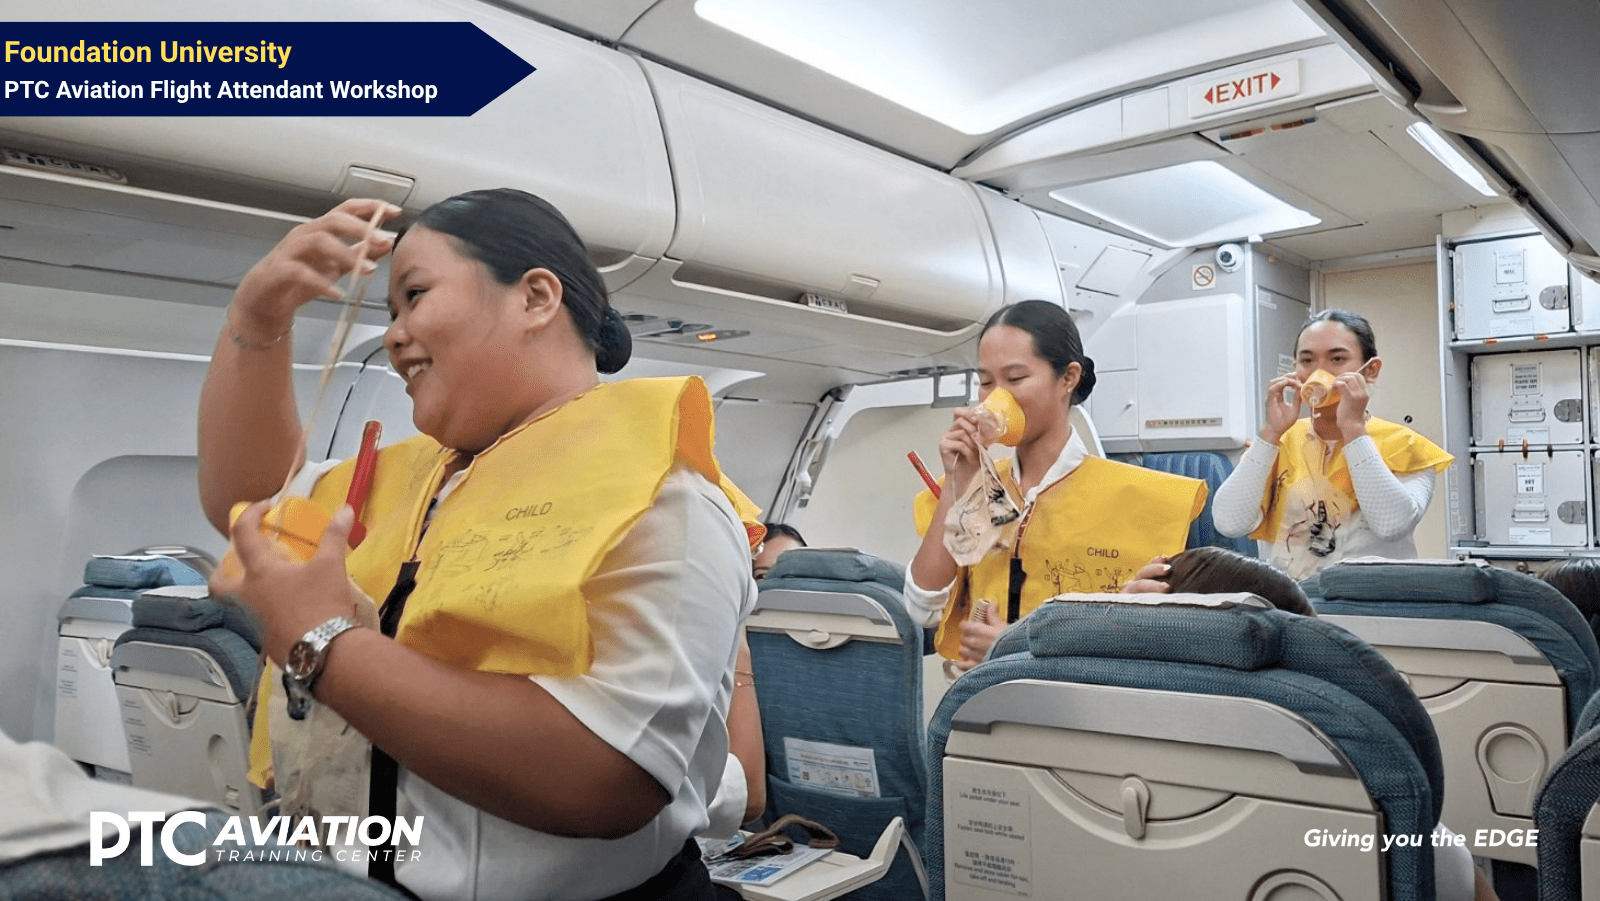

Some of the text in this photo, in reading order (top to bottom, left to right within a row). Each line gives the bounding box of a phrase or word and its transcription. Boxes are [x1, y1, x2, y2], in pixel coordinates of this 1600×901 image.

[1216, 73, 1268, 104] EXIT
[505, 501, 553, 521] CHILD
[1087, 547, 1119, 559] CHILD
